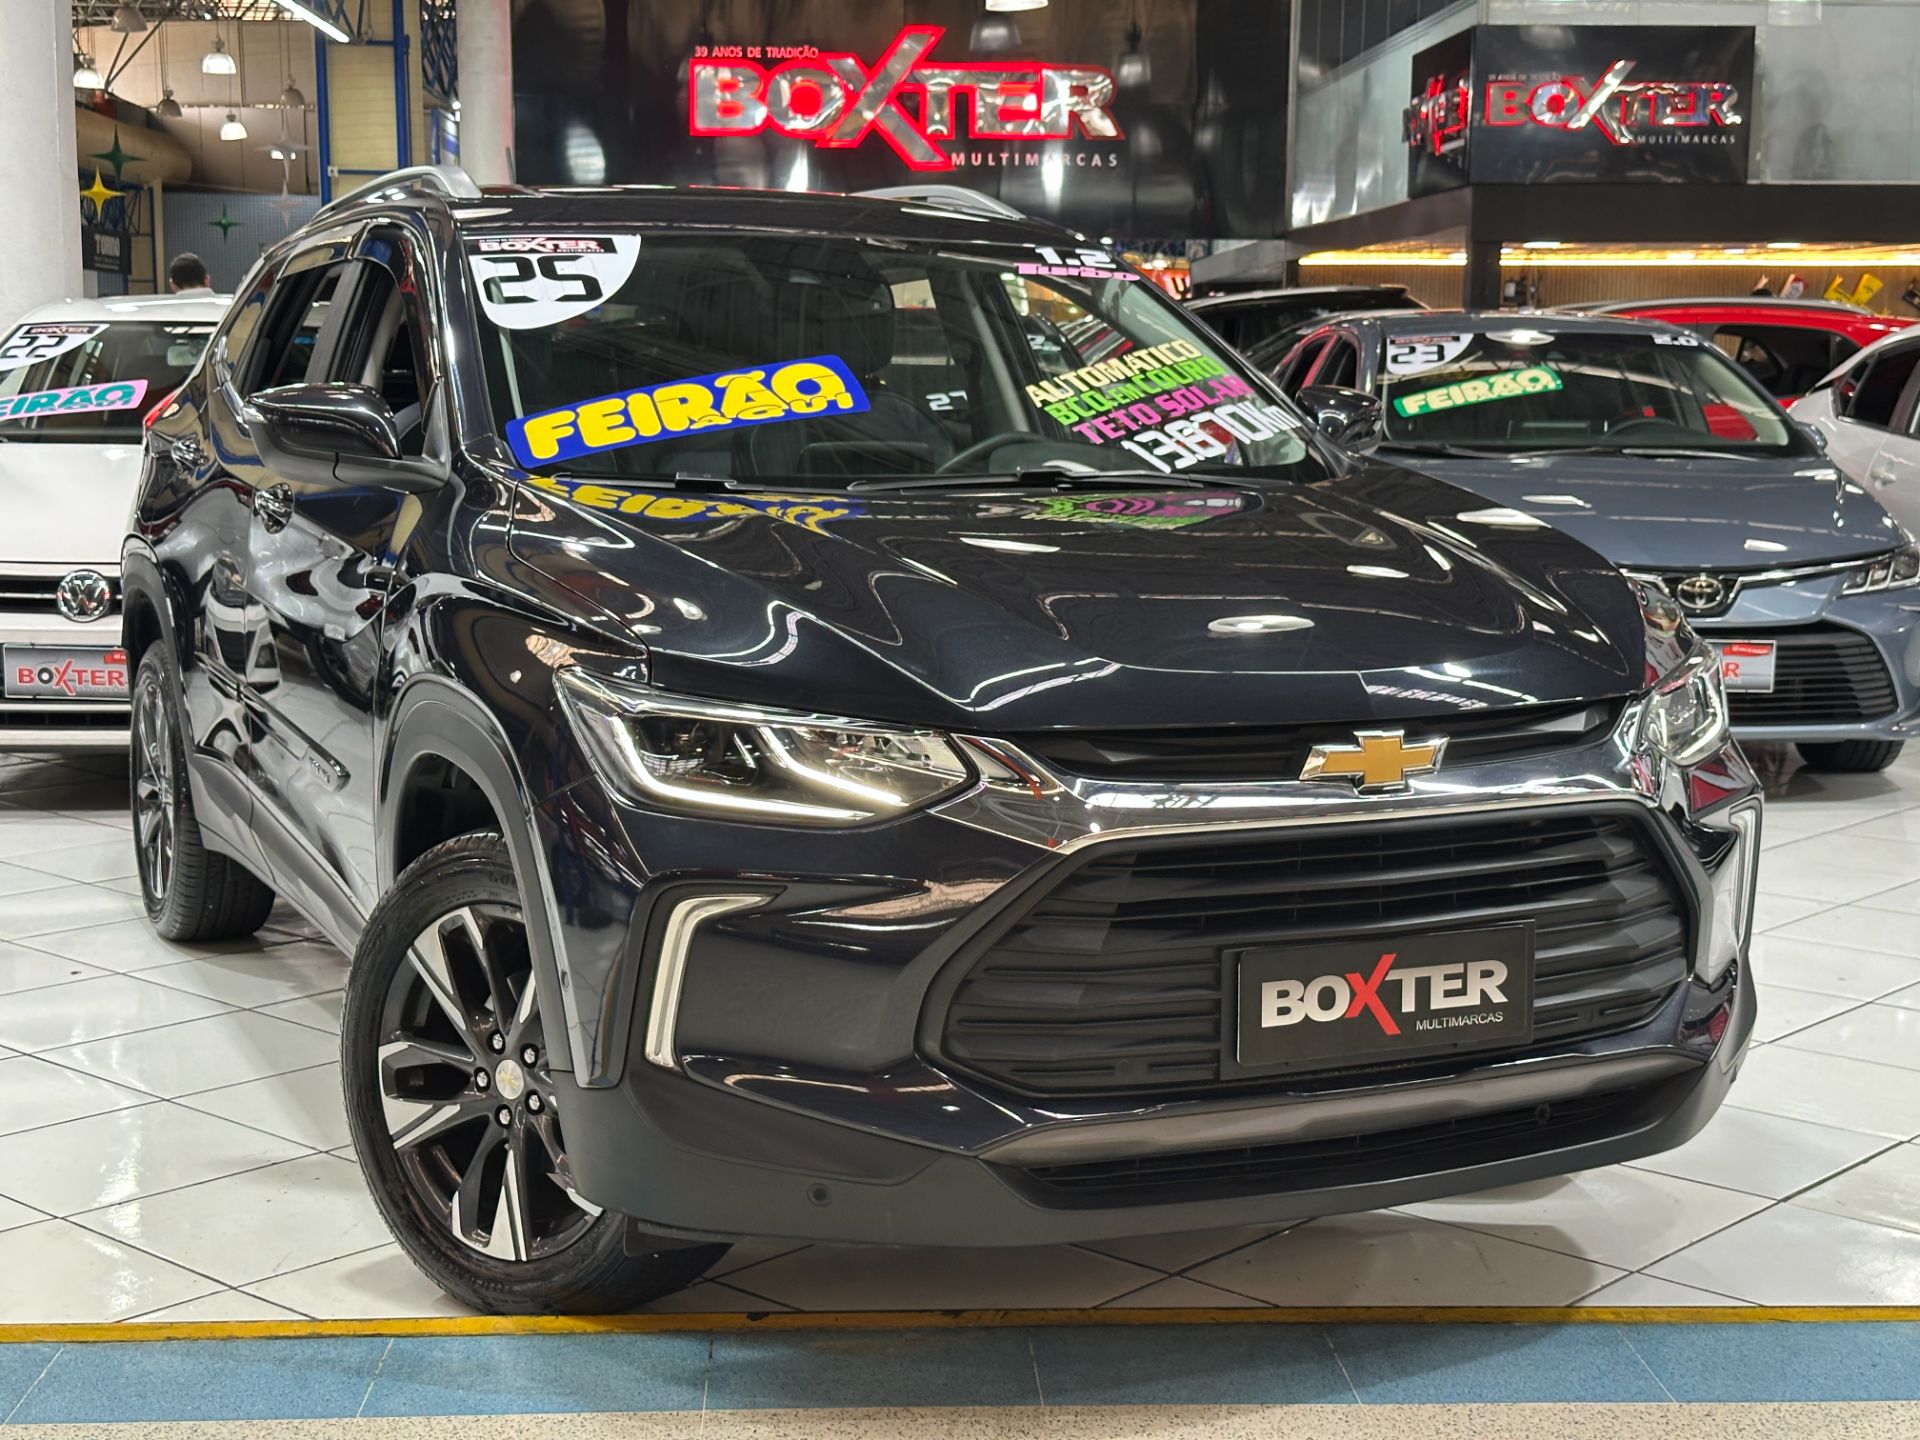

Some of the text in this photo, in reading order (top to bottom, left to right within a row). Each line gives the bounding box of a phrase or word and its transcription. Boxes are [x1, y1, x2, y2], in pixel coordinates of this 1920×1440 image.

[694, 44, 819, 60] 39 ANOS DE TRADIÇÃO
[689, 25, 1125, 171] BOXTER
[1485, 60, 1743, 146] BOXTER
[1637, 135, 1736, 145] MULTIMARCAS
[951, 151, 1119, 168] MULTIMARCAS
[478, 237, 603, 253] BOXTER
[1035, 246, 1117, 269] 1.2
[481, 255, 603, 304] 25
[1, 335, 69, 358] 22
[1391, 344, 1446, 364] 23
[1131, 356, 1225, 394] COURO
[1401, 368, 1553, 415] FEIRÃO
[523, 363, 847, 459] FEIRÃO
[1072, 374, 1255, 445] TETO SOLAR
[16, 658, 125, 696] BOXTER
[1261, 953, 1509, 1035] BOXTER
[1416, 1011, 1504, 1031] MULTIMARCAS
